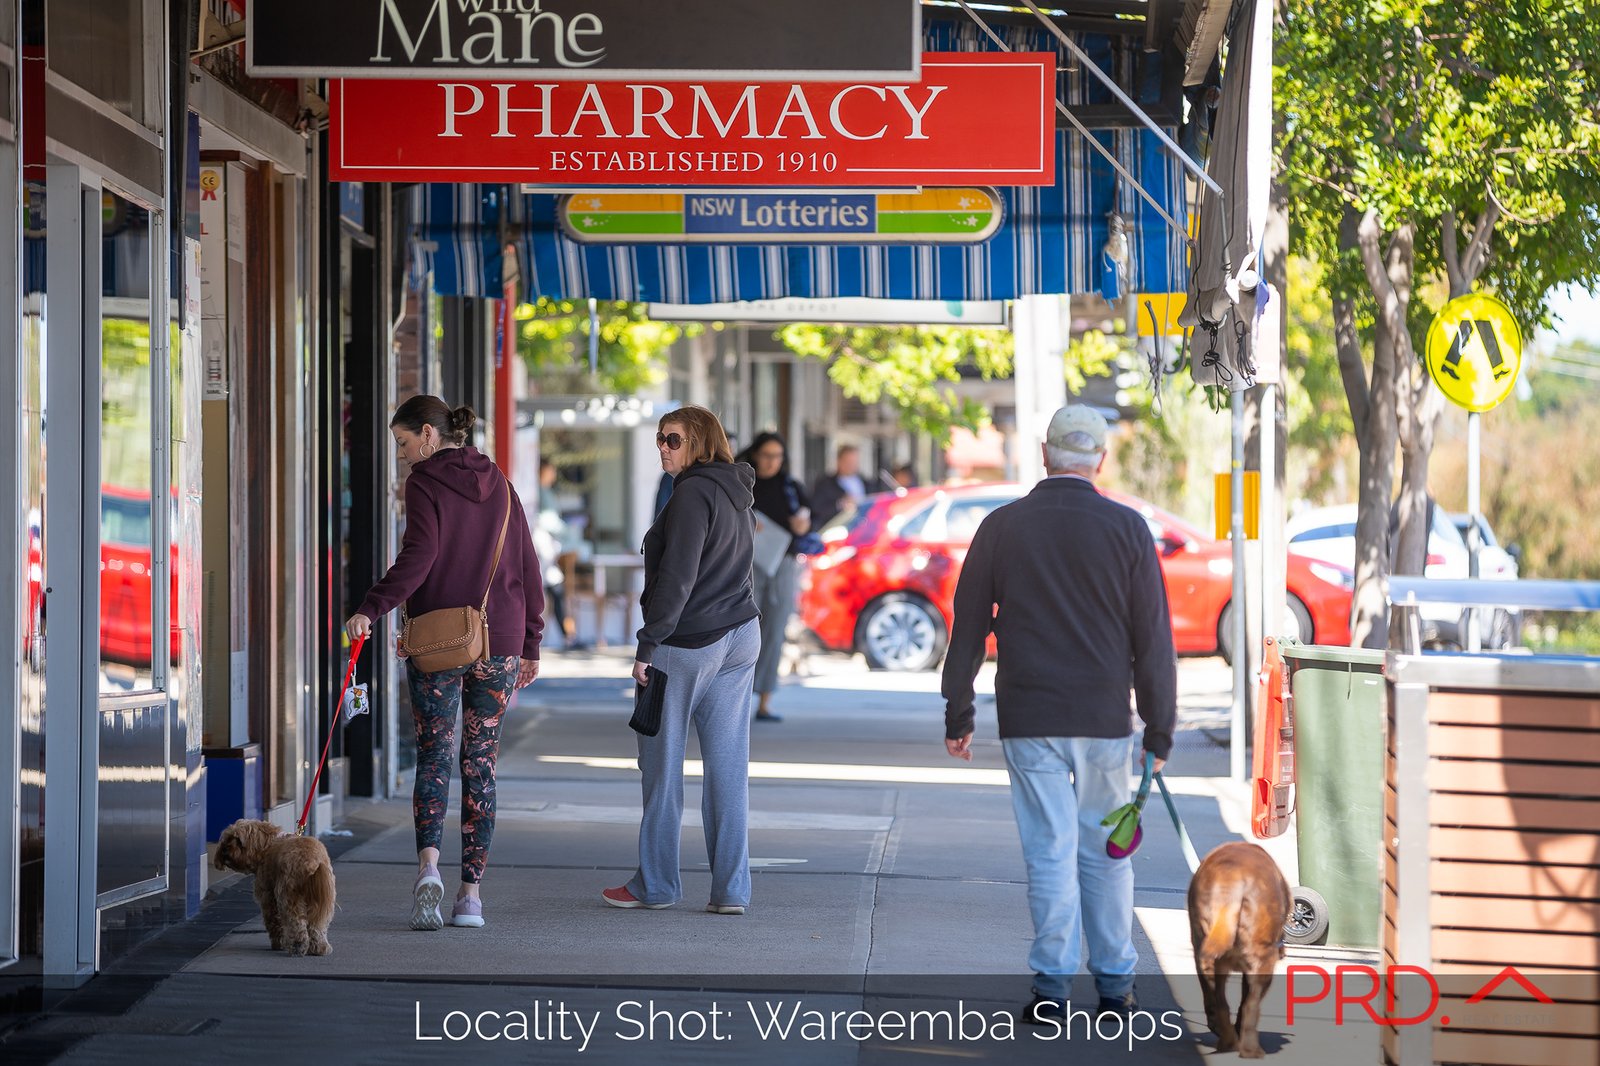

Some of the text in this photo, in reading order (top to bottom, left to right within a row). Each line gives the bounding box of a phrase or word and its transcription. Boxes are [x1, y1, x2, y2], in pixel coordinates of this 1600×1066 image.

[369, 0, 607, 67] Mane
[437, 83, 949, 140] PHARMACY
[549, 151, 838, 173] ESTABLISHED 1910
[691, 197, 869, 228] NSW Lotteries
